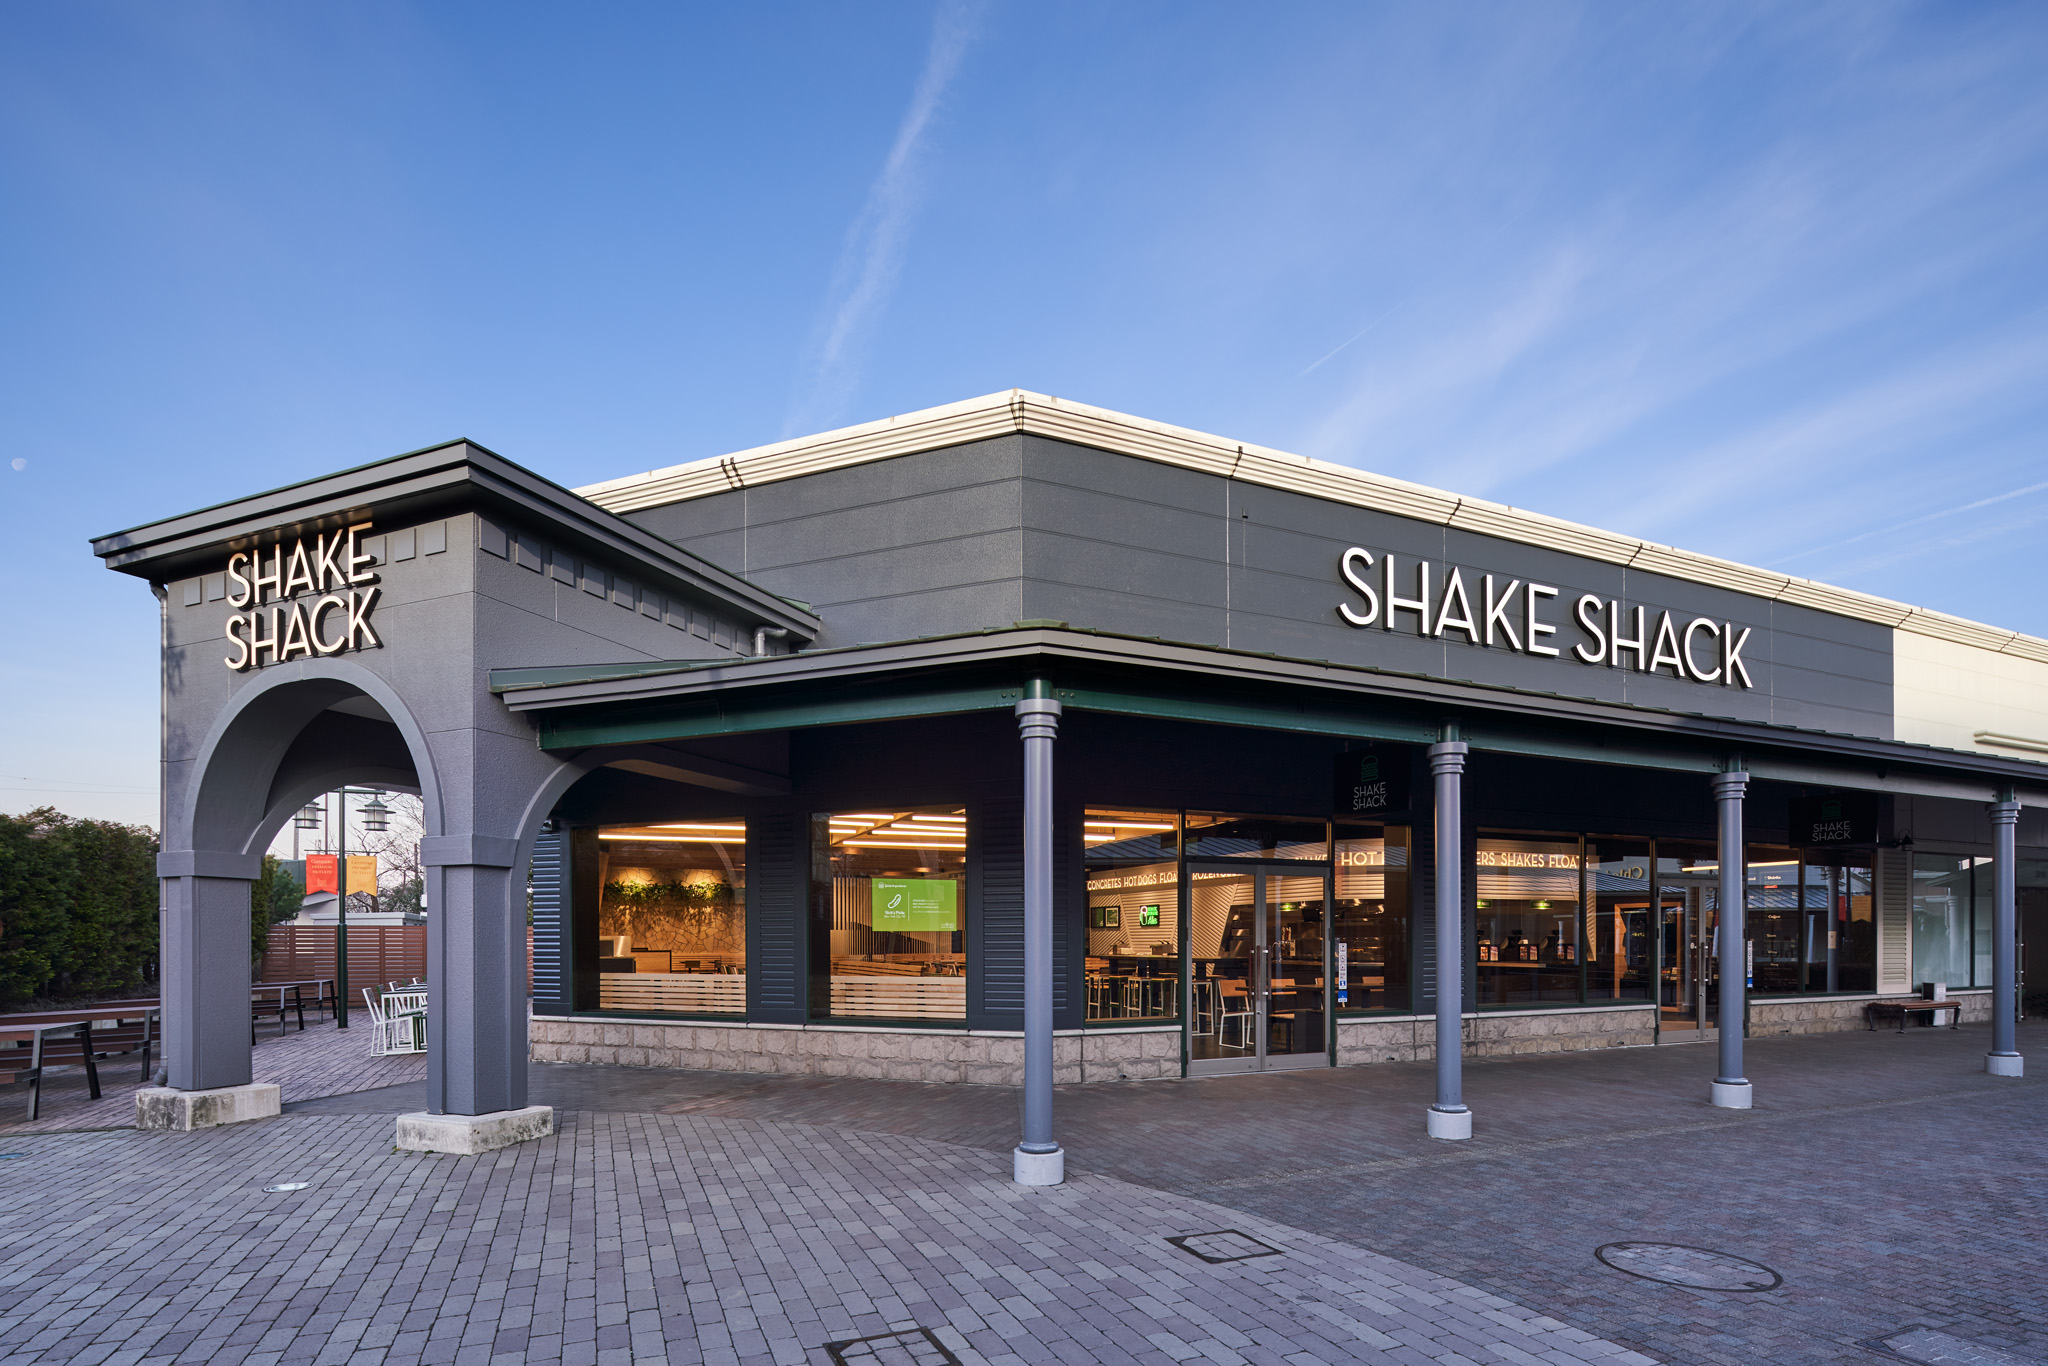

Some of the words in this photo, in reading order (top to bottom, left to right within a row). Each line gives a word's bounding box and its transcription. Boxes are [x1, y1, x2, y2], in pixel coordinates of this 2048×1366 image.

[227, 522, 375, 608] SHAKE
[1335, 547, 1560, 657] SHAKE
[1571, 595, 1754, 689] SHACK
[224, 587, 378, 670] SHACK
[1353, 781, 1387, 798] SHAKE
[1352, 793, 1387, 811] SHACK
[1812, 820, 1851, 833] SHAKE
[1811, 830, 1852, 842] SHACK
[1341, 851, 1377, 866] HOT
[1501, 852, 1545, 868] SHAKES
[1087, 878, 1122, 890] CONCRETES
[1138, 874, 1157, 886] DOGS
